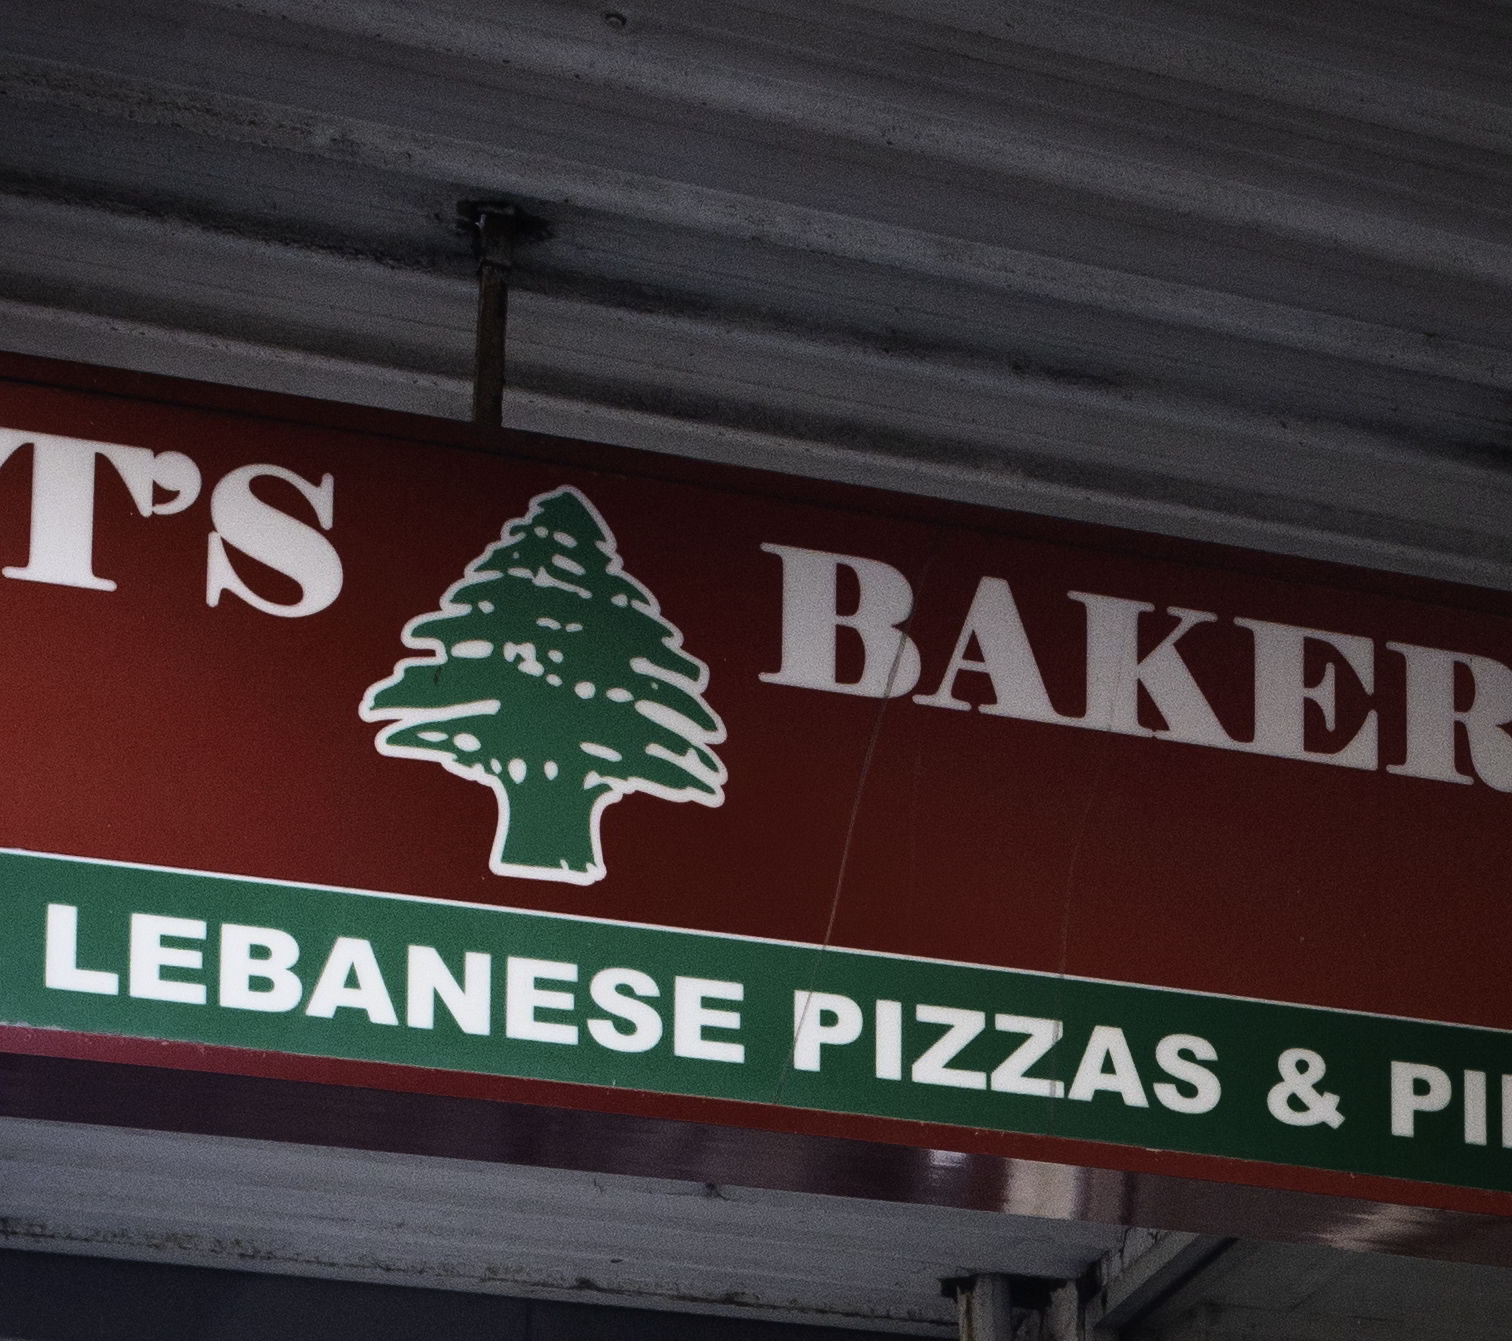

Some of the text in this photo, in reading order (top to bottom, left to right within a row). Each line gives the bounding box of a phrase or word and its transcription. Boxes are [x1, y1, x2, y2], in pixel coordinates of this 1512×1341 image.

[44, 903, 745, 1065] LEBANESE
[792, 988, 1222, 1114] PIZZAS
[1267, 1047, 1346, 1130] &
